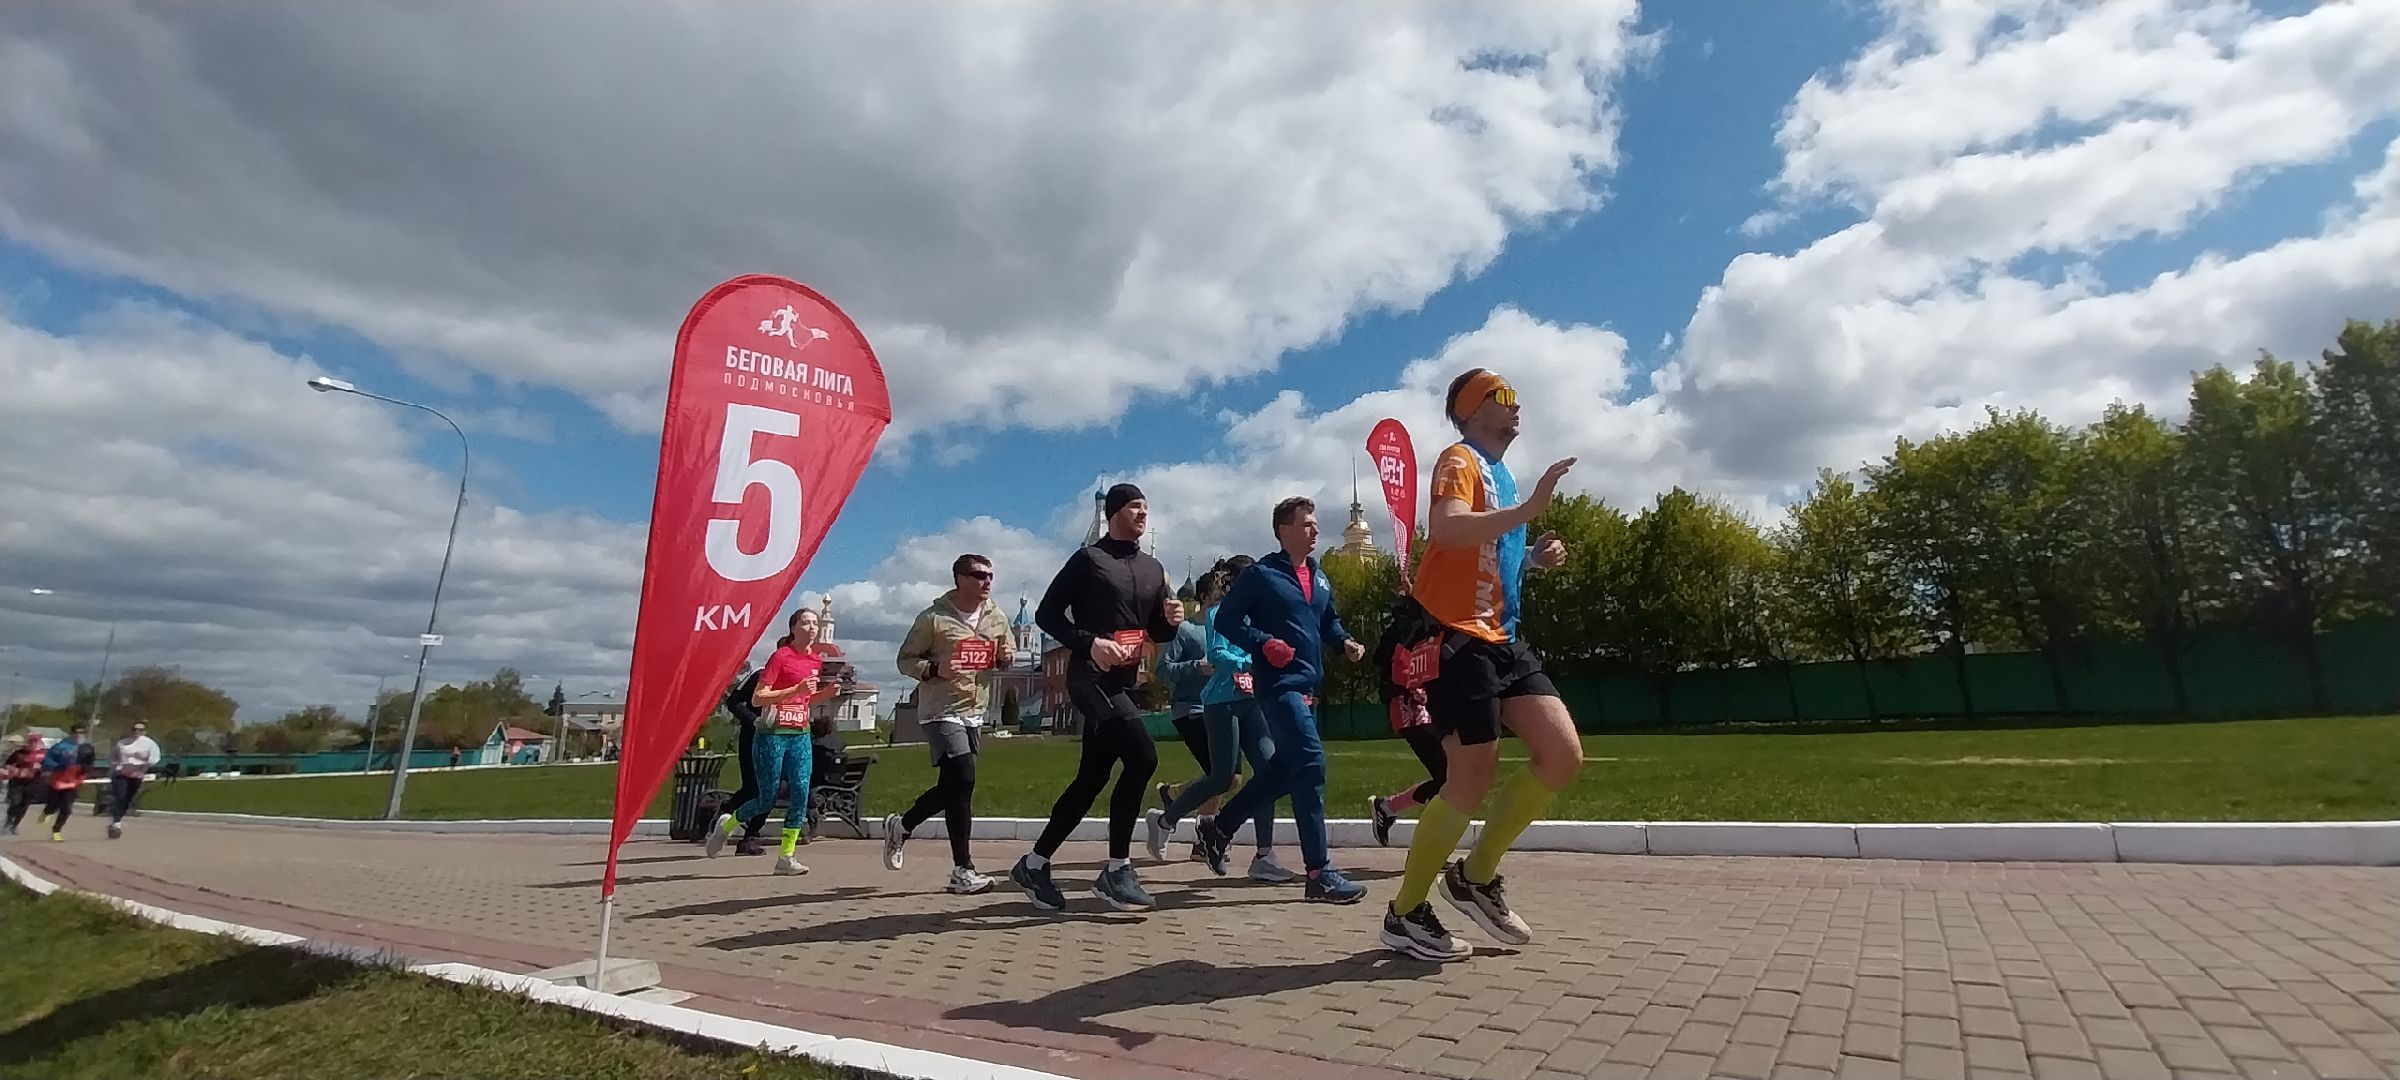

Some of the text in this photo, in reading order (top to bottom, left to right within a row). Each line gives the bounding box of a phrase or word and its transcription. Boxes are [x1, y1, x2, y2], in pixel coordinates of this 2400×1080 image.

[726, 345, 854, 396] БЕГОВАЯ ЛИГА
[723, 372, 856, 412] ПОДМОСКОВЬЯ
[704, 402, 803, 582] 5
[693, 602, 752, 632] КМ
[960, 650, 987, 664] 5122
[1409, 652, 1427, 675] 5111
[1238, 676, 1253, 689] 50
[779, 711, 804, 722] 5048
